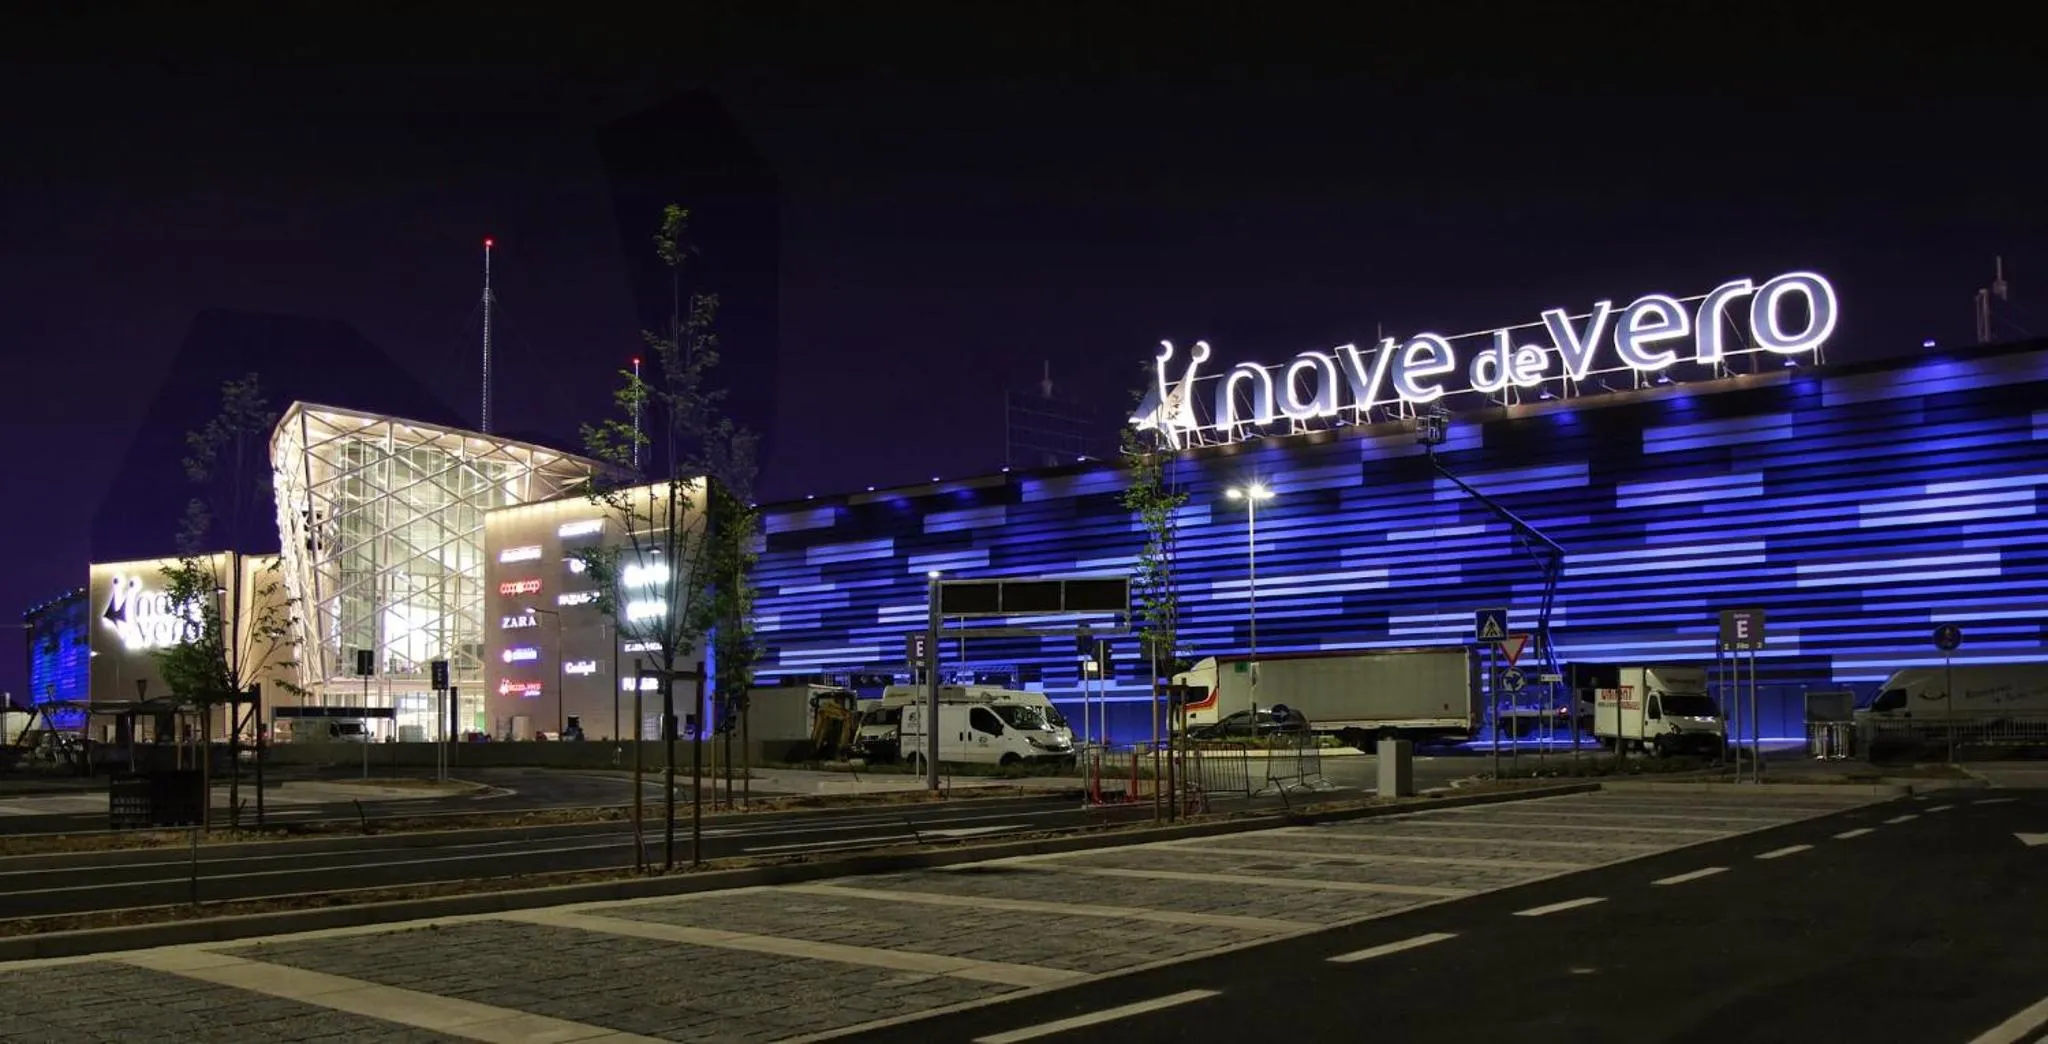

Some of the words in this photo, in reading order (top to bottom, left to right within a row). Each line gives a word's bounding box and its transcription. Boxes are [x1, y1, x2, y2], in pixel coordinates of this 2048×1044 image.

[1215, 332, 1455, 431] nave
[1469, 329, 1549, 393] de
[1541, 271, 1838, 382] vero
[502, 615, 537, 629] ZARA
[1736, 619, 1749, 639] E
[916, 640, 924, 657] E
